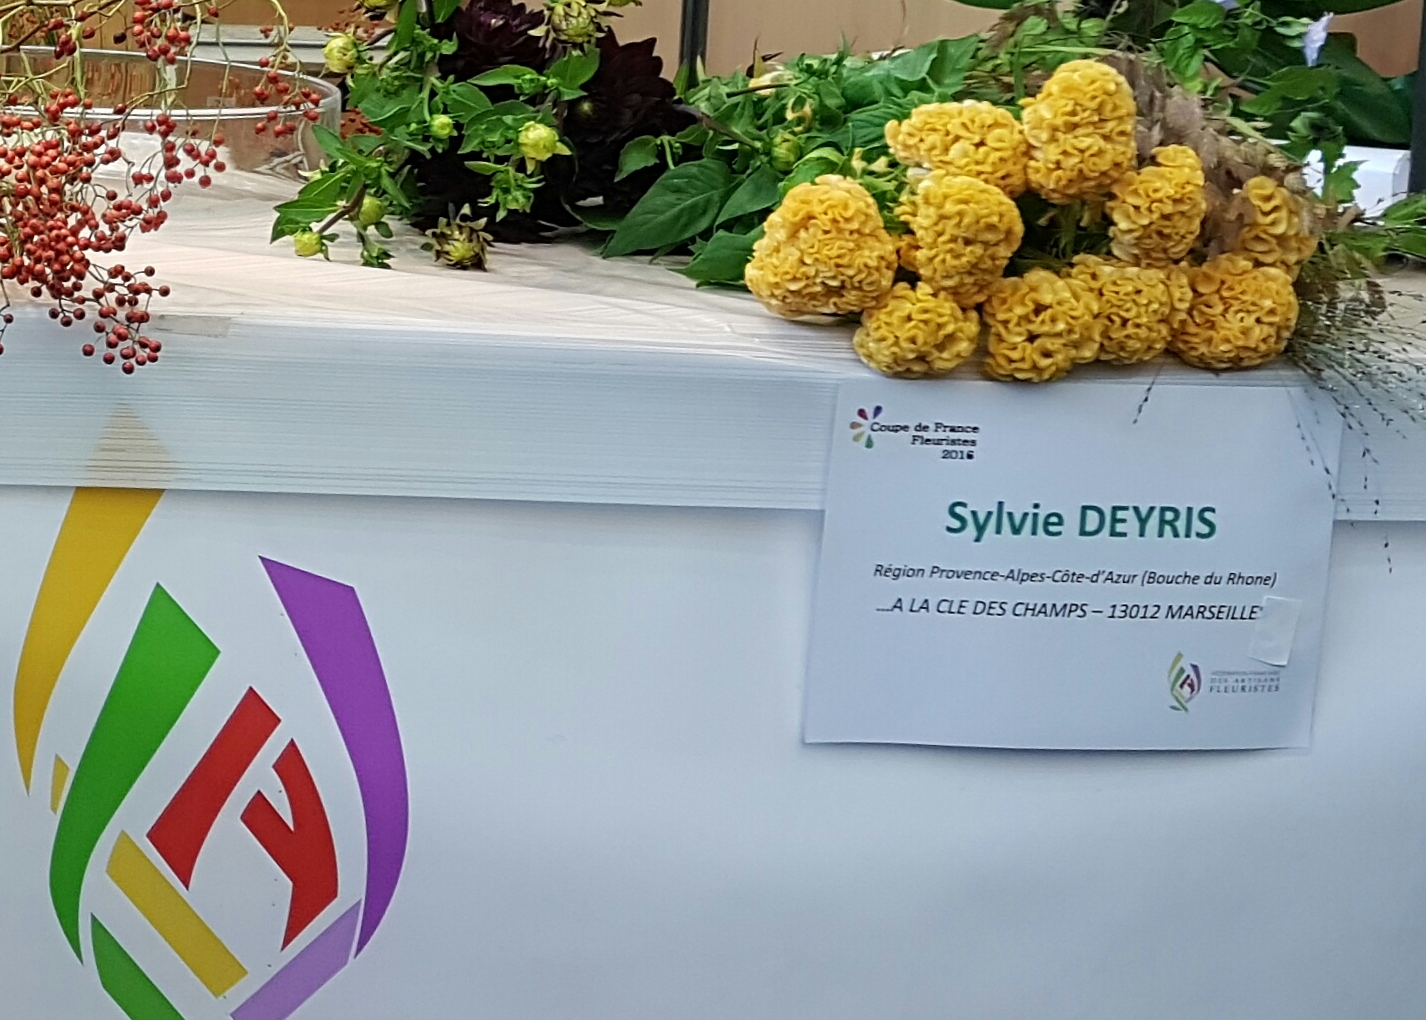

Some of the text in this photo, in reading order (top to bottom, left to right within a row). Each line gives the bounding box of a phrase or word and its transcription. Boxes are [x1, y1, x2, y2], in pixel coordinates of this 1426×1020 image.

[870, 422, 980, 433] Coupe de France
[911, 435, 977, 447] Fleuristes
[941, 449, 975, 460] 2016
[945, 500, 1217, 543] Sylvie DEYRIS
[874, 564, 925, 581] Région
[1141, 570, 1200, 587] (Bouche
[1203, 571, 1222, 585] du
[1226, 572, 1278, 588] Rhone)
[909, 598, 930, 613] LA
[936, 598, 969, 615] CLE
[972, 600, 1008, 616] DES
[1012, 602, 1088, 619] CHAMPS
[1107, 604, 1161, 619] 13012
[1210, 685, 1280, 693] FLEURISTES
